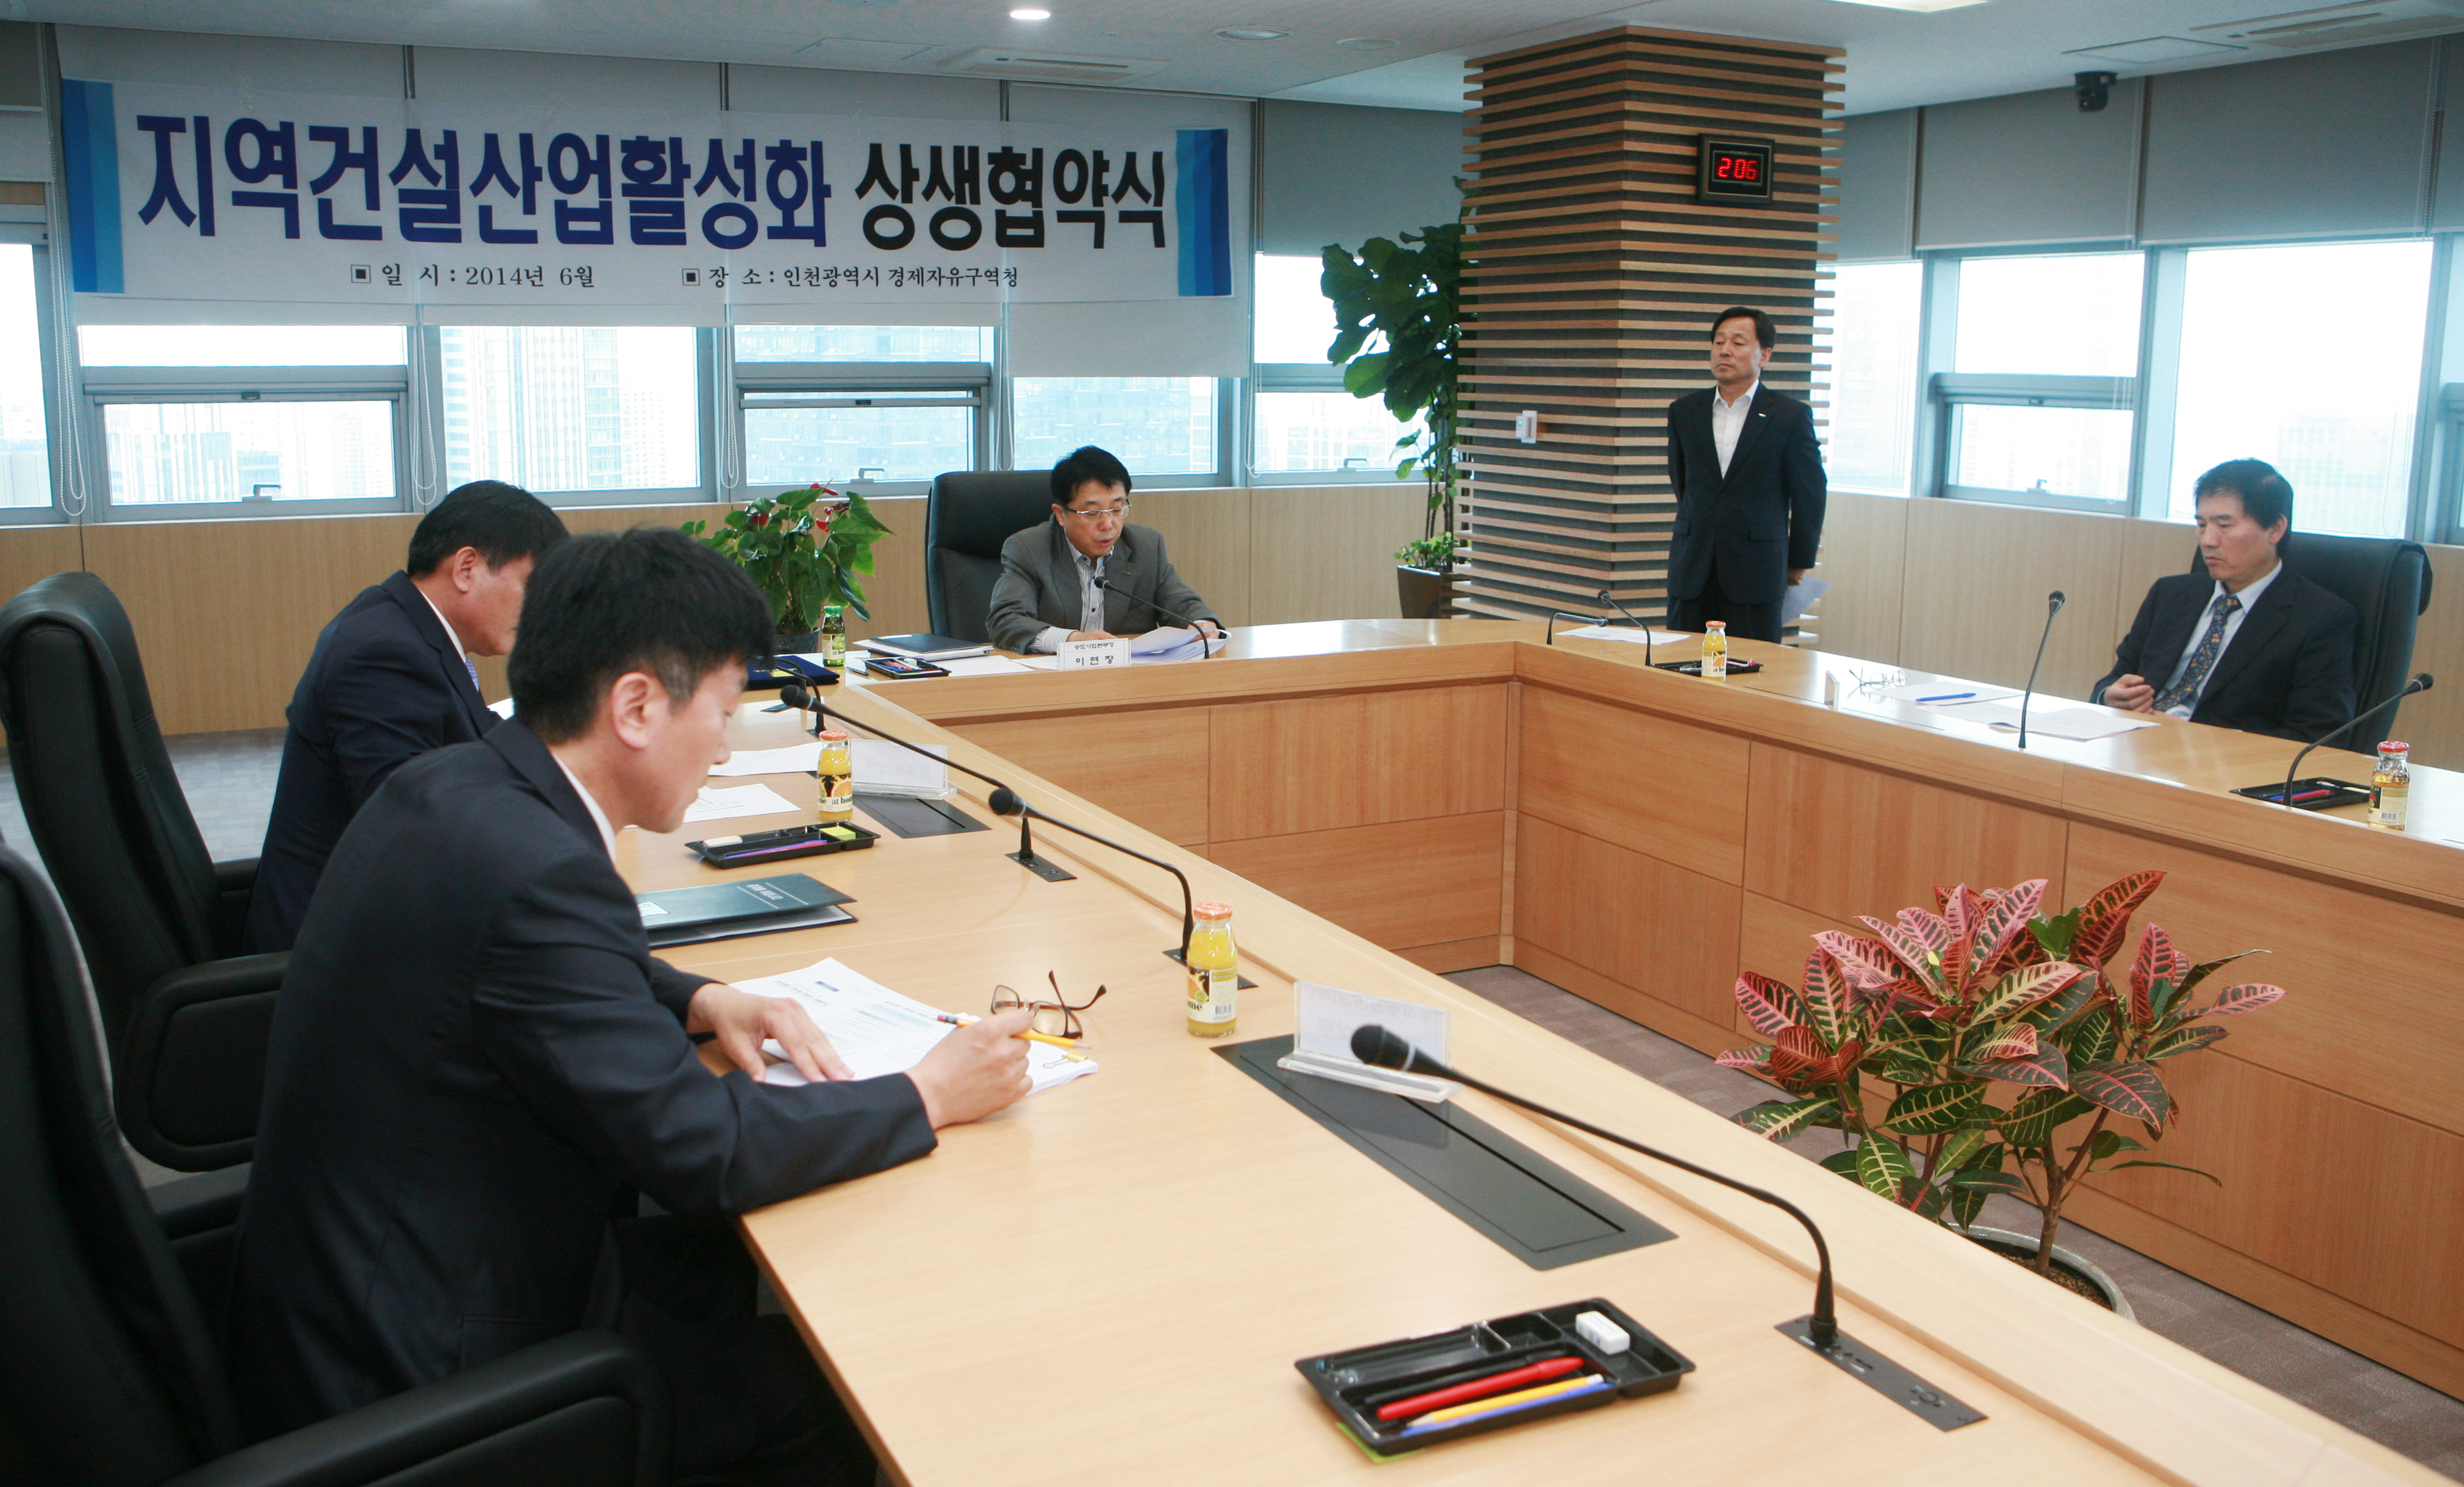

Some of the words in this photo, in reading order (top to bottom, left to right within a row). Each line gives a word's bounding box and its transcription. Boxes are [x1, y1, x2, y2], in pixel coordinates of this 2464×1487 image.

[136, 114, 832, 250] 지역건설산업활성화
[854, 143, 1166, 251] 상생협약식
[559, 266, 595, 288] 6월
[784, 266, 879, 288] 인천광역시
[888, 266, 1018, 288] 경제자유구역청
